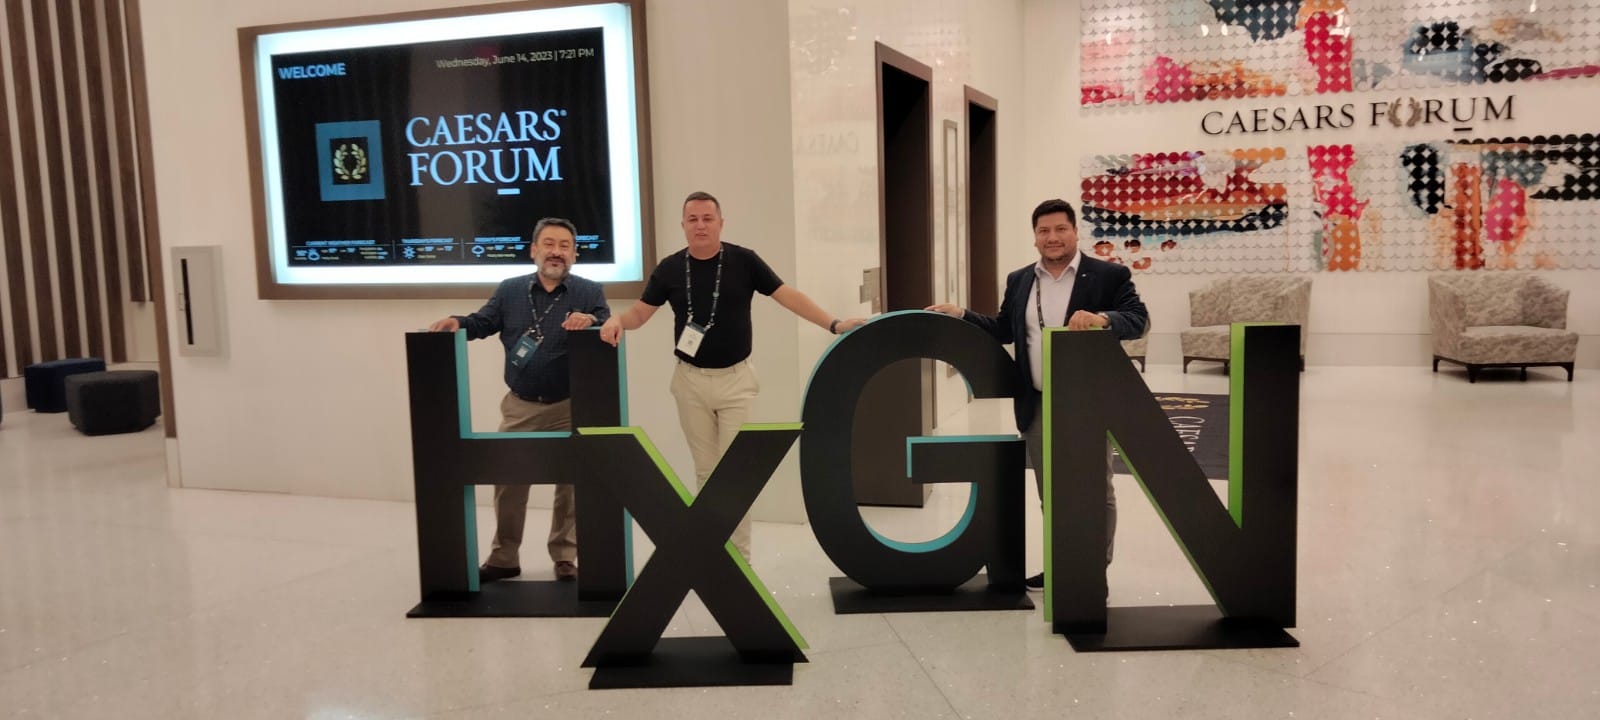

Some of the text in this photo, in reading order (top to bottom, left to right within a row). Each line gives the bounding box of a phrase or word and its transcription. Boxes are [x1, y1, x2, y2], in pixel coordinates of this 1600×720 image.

[278, 62, 346, 79] WELCOME
[435, 56, 491, 68] Wednesday,
[492, 55, 516, 65] June
[531, 51, 553, 62] 2023
[578, 48, 595, 58] PM
[1201, 103, 1354, 136] CAESARS
[407, 146, 563, 188] FORUM
